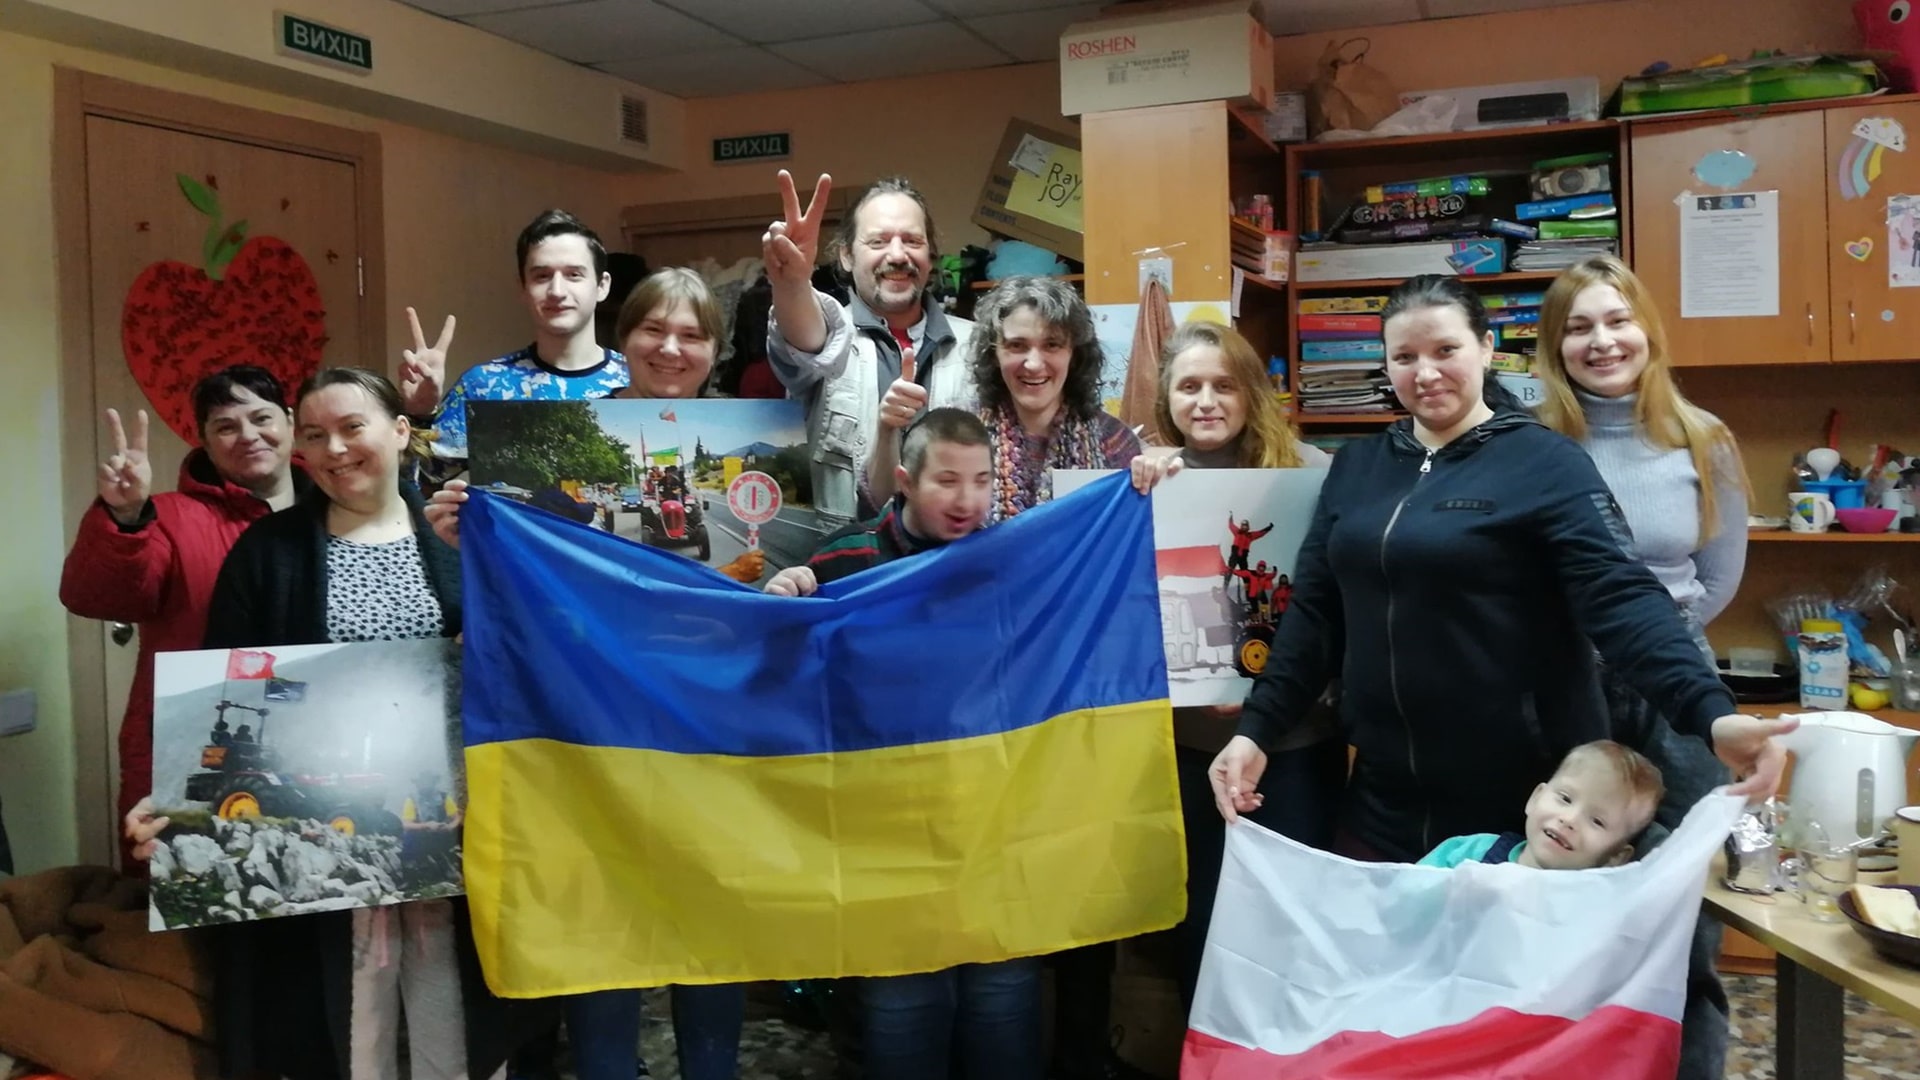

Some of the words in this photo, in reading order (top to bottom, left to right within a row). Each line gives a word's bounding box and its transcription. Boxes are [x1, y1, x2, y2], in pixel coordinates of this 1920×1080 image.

[292, 21, 365, 65] ВИХІД
[1067, 35, 1136, 59] ROSHEN
[720, 136, 782, 157] ВИХІД
